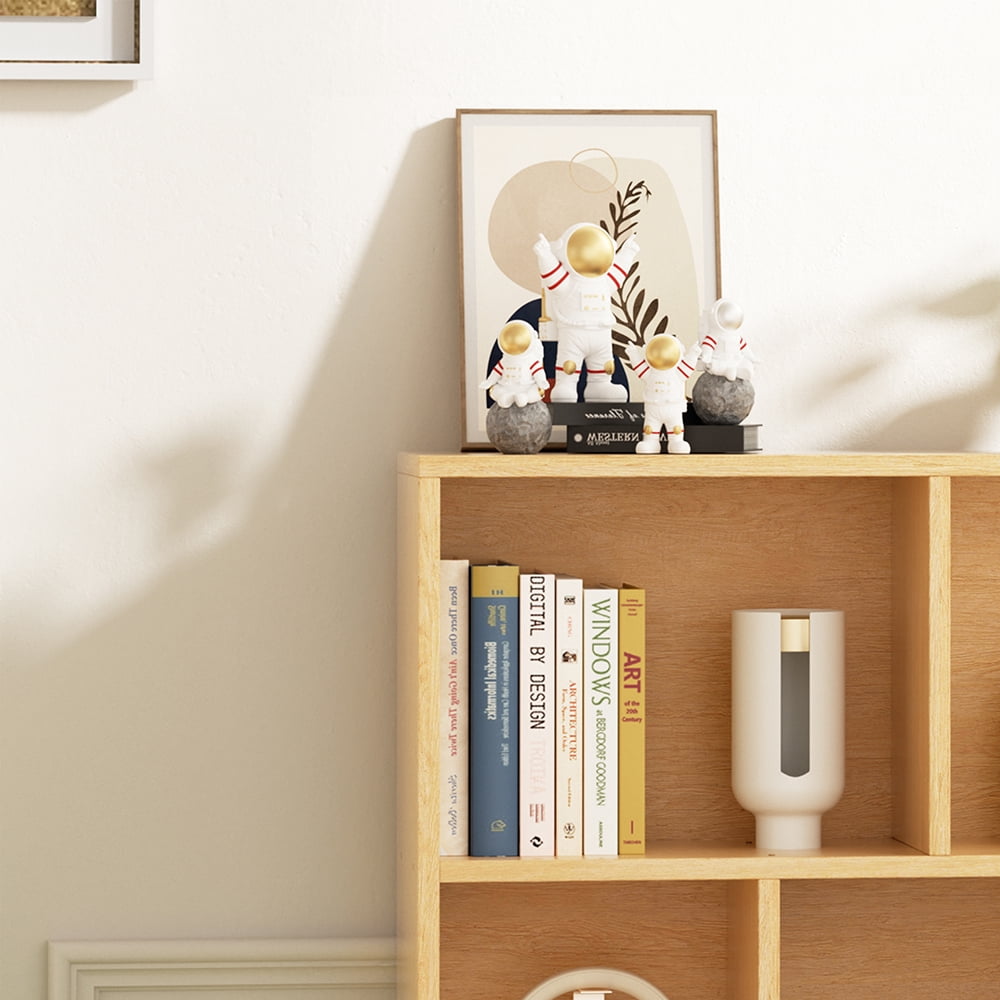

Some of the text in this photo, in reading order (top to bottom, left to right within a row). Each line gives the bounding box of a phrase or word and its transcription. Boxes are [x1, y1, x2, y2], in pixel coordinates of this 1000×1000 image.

[530, 576, 545, 730] DIGITAL BY DESIGN
[592, 599, 611, 706] WINDOWS
[624, 652, 641, 693] ART
[569, 680, 577, 761] ARCHITECTURE
[596, 718, 607, 761] BERGDORF
[622, 716, 642, 724] Century
[596, 762, 607, 806] GOODMAN
